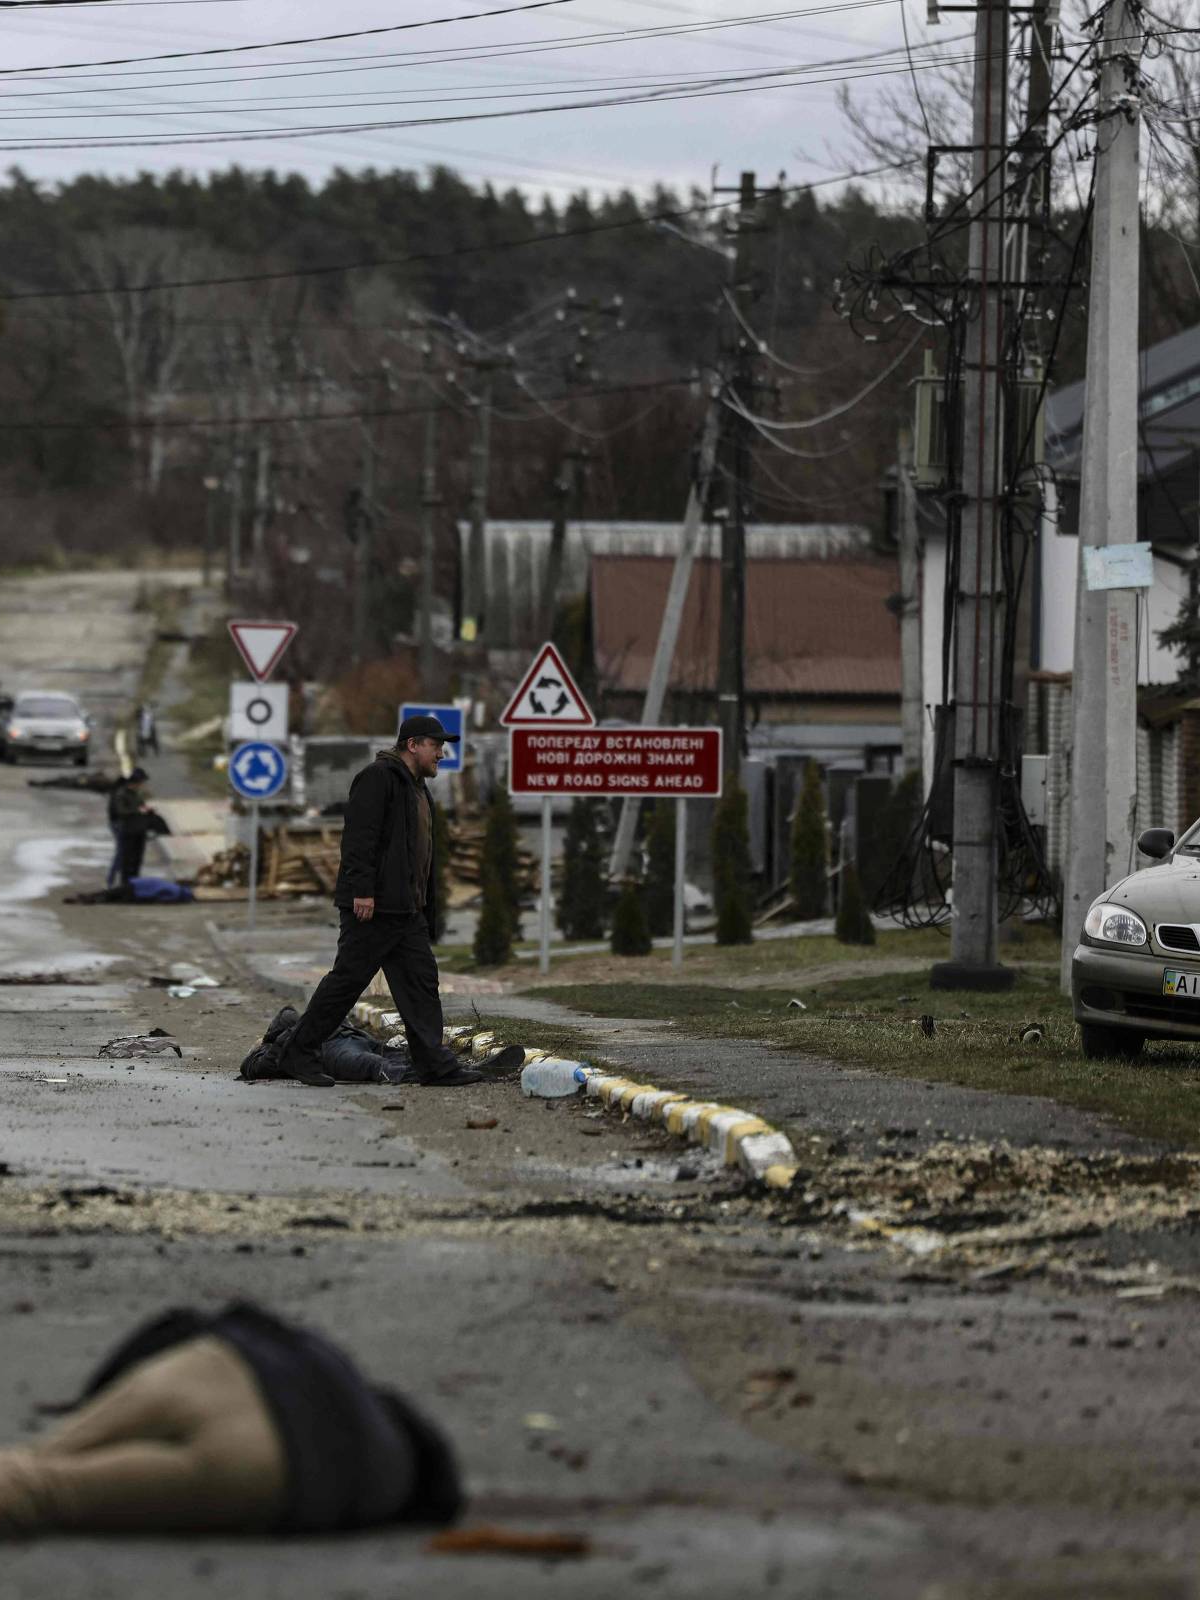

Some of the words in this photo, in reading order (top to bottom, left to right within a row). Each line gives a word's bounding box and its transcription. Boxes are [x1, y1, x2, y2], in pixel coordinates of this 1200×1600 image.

[527, 736, 600, 750] ПОПЕРЕДУ
[606, 736, 704, 750] ВСТАНОВЛЕНІ
[537, 752, 570, 764] НОВІ
[574, 752, 641, 766] ДОРОЖНІ
[647, 753, 695, 765] ЗНАКИ
[527, 774, 559, 786] NEW
[563, 774, 603, 786] ROAD
[607, 774, 649, 787] SIGNS
[655, 775, 704, 787] AHEAD
